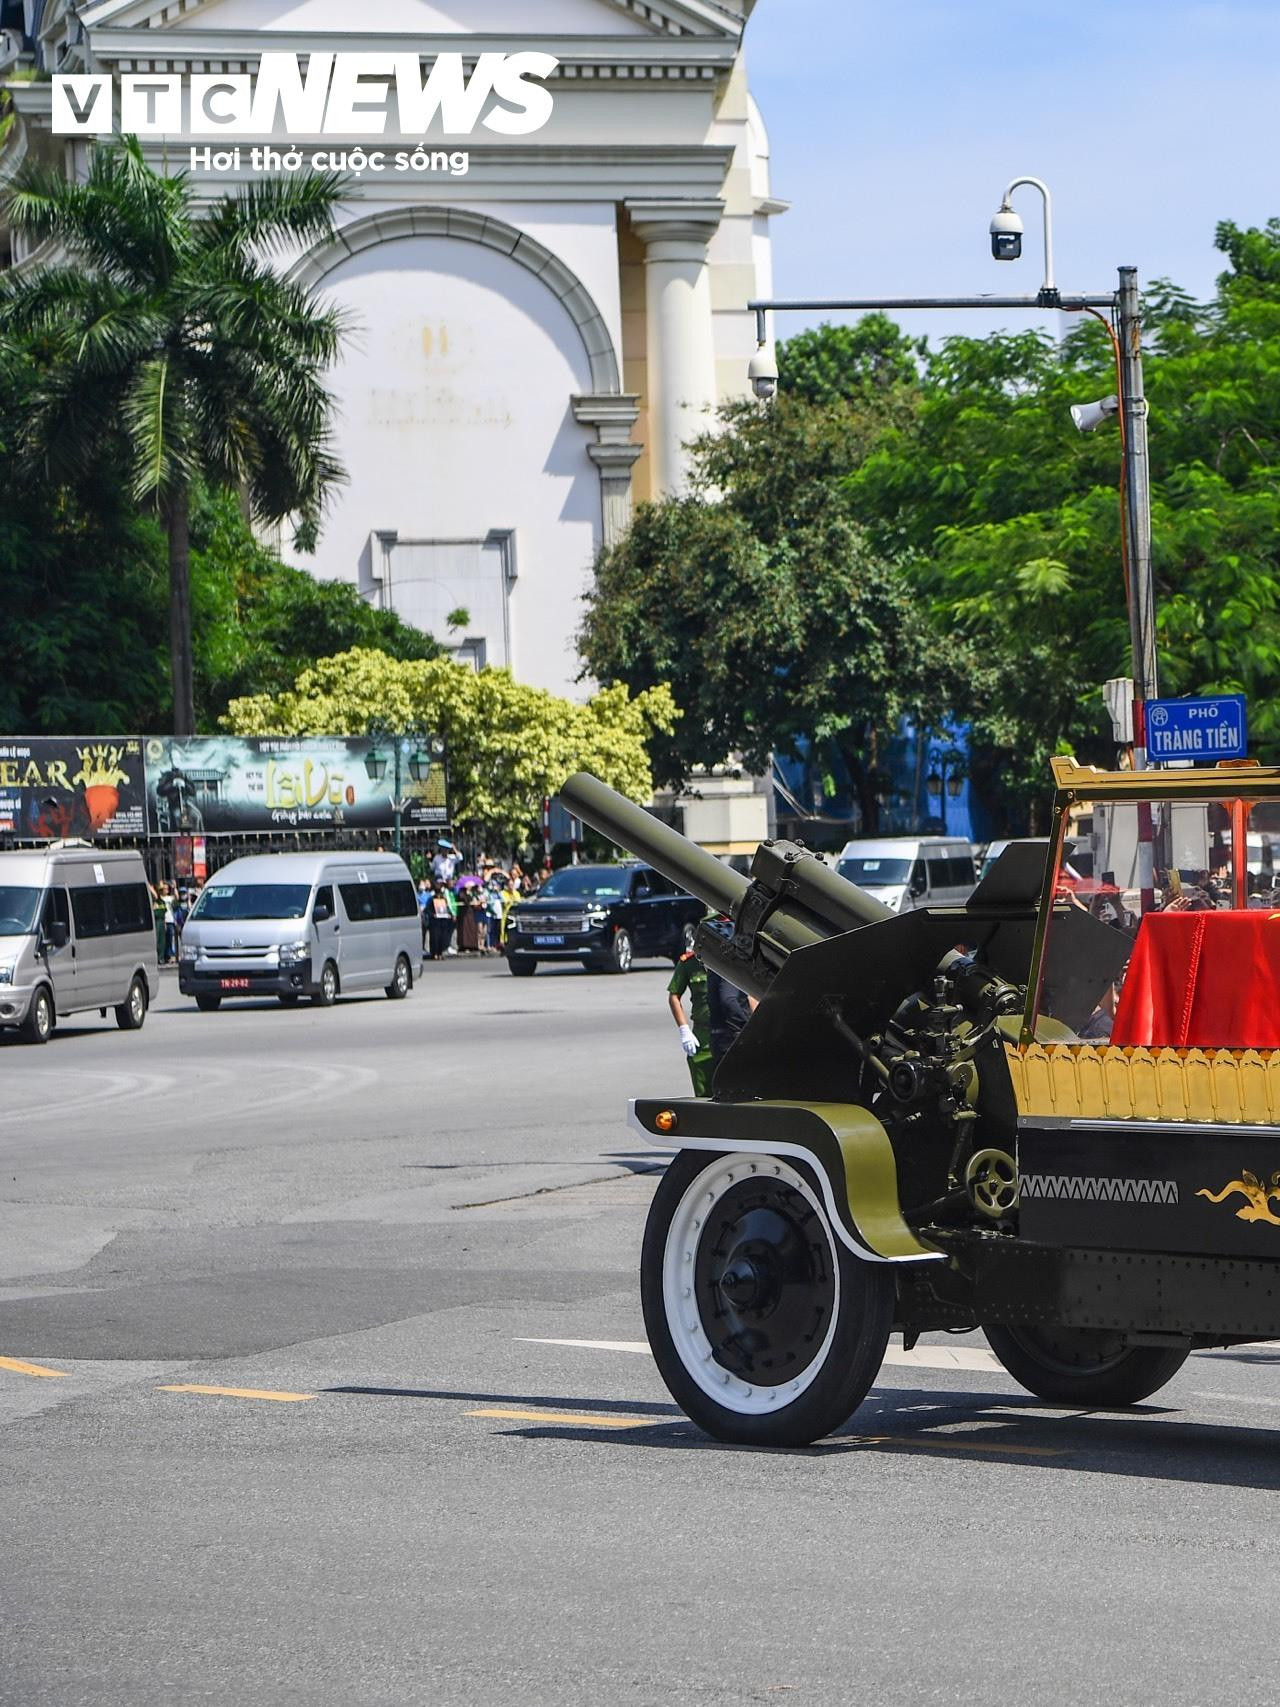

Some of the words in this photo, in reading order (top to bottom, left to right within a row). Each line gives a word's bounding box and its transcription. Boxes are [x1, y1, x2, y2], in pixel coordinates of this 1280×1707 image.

[1188, 702, 1219, 719] PHỐ
[1154, 724, 1203, 752] TRÀNG
[1206, 720, 1238, 749] TIỀN
